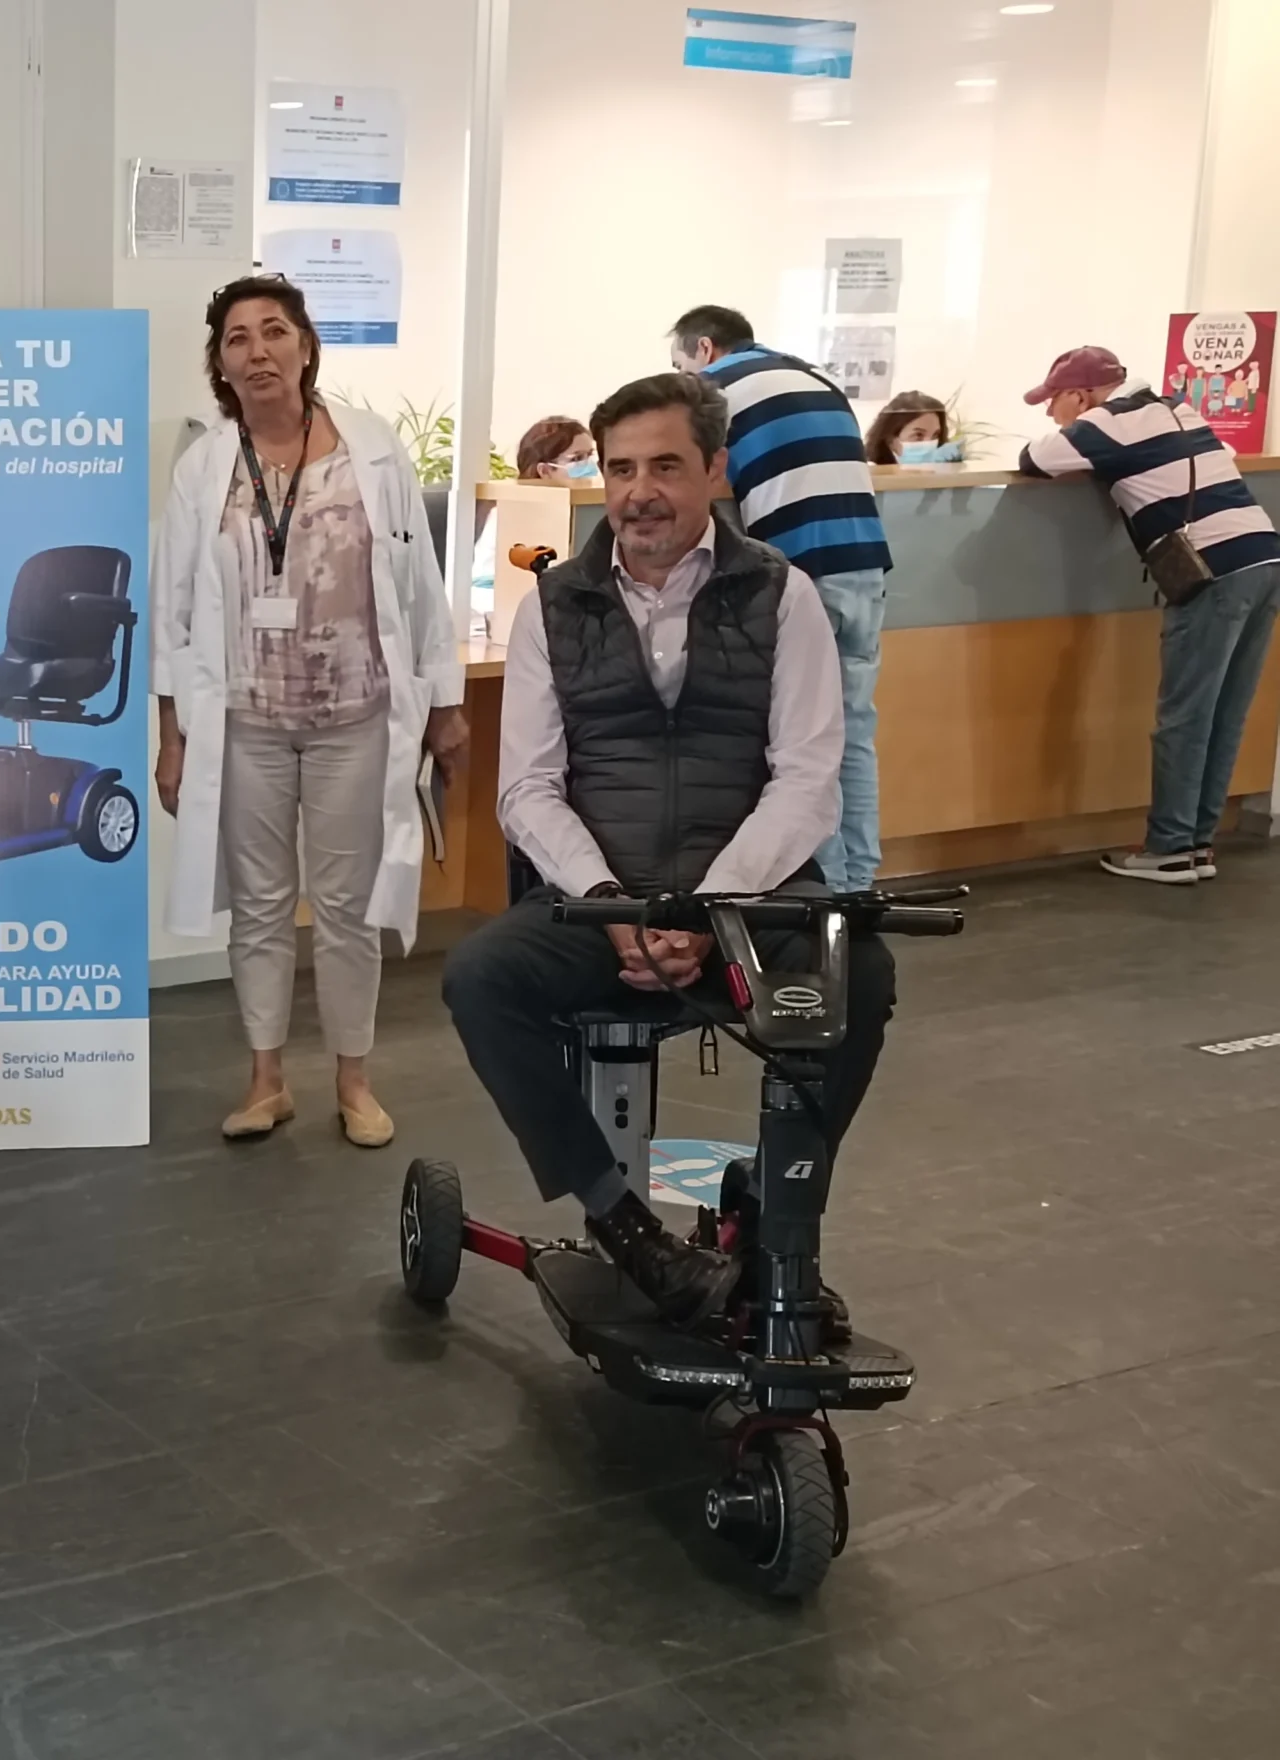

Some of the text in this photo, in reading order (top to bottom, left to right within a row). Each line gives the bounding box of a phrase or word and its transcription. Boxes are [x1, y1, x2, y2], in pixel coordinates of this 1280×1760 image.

[1194, 337, 1245, 349] VEN A
[16, 339, 71, 368] TU
[5, 457, 36, 475] del
[41, 457, 123, 479] hospital
[47, 964, 122, 980] AYUDA
[2, 1052, 59, 1064] Servicio
[63, 1050, 135, 1063] Madrileño
[2, 1068, 20, 1079] de
[24, 1067, 64, 1079] Salud
